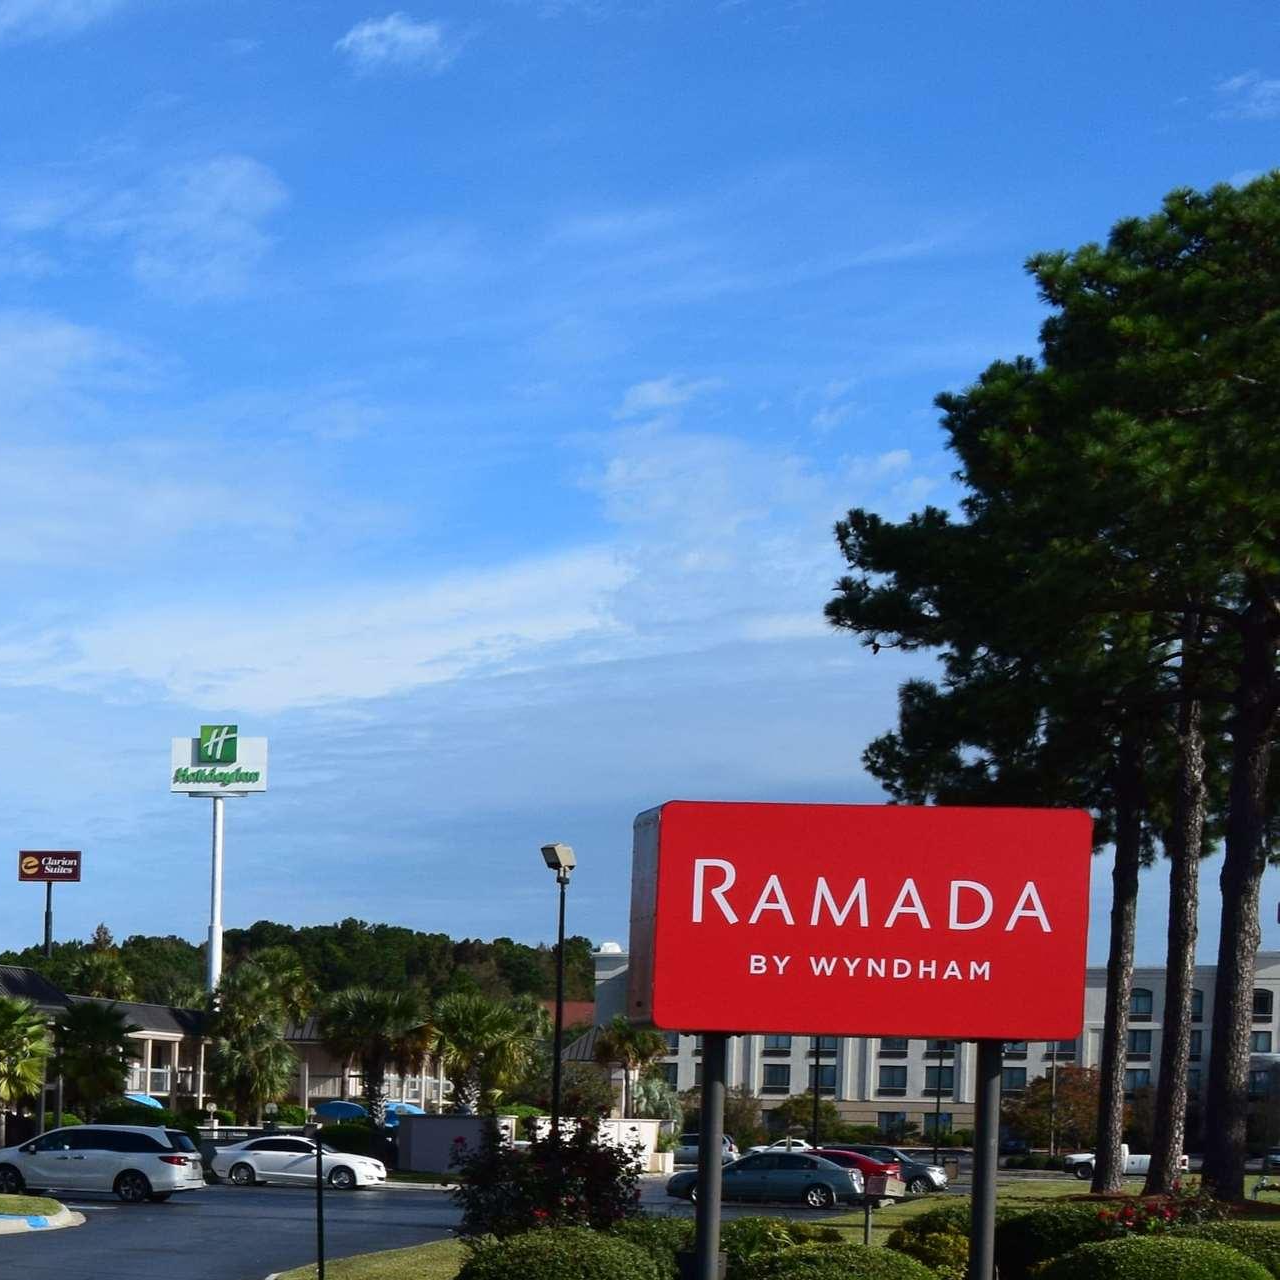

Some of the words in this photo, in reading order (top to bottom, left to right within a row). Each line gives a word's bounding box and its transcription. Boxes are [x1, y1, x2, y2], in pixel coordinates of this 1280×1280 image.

[173, 767, 234, 787] Holiday
[41, 857, 77, 866] Clarion
[692, 858, 1052, 933] RAMADA
[749, 954, 791, 975] BY
[809, 956, 991, 981] WYNDHAM
